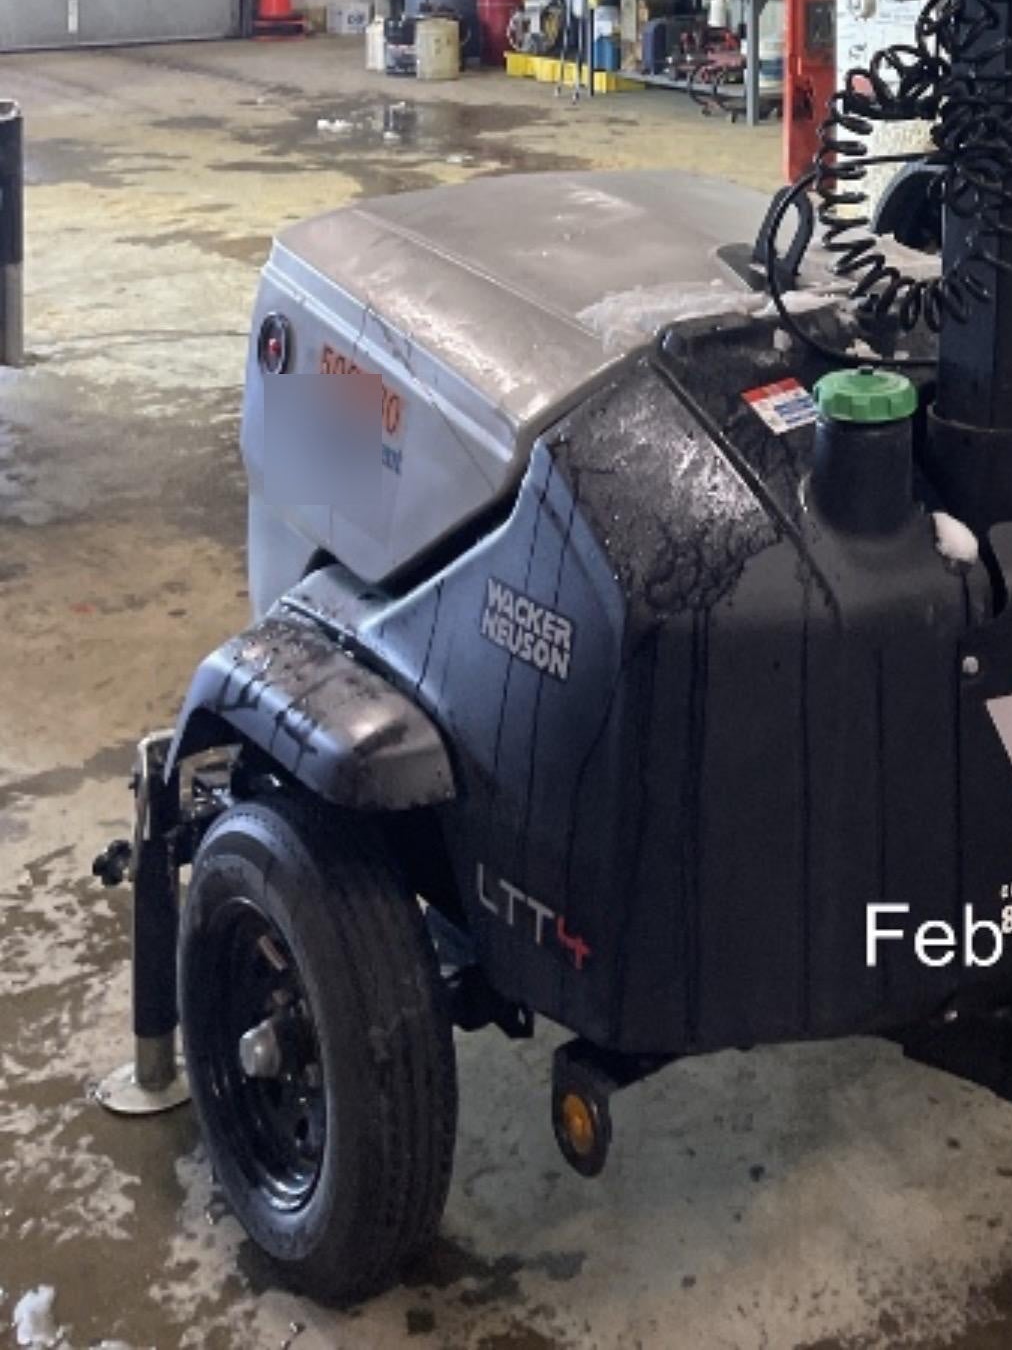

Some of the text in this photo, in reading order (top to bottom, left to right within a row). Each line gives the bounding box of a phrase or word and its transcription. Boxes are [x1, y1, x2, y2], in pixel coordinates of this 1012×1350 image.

[481, 608, 570, 680] NEUSON
[487, 577, 572, 652] WACKER
[476, 862, 590, 970] LTT4
